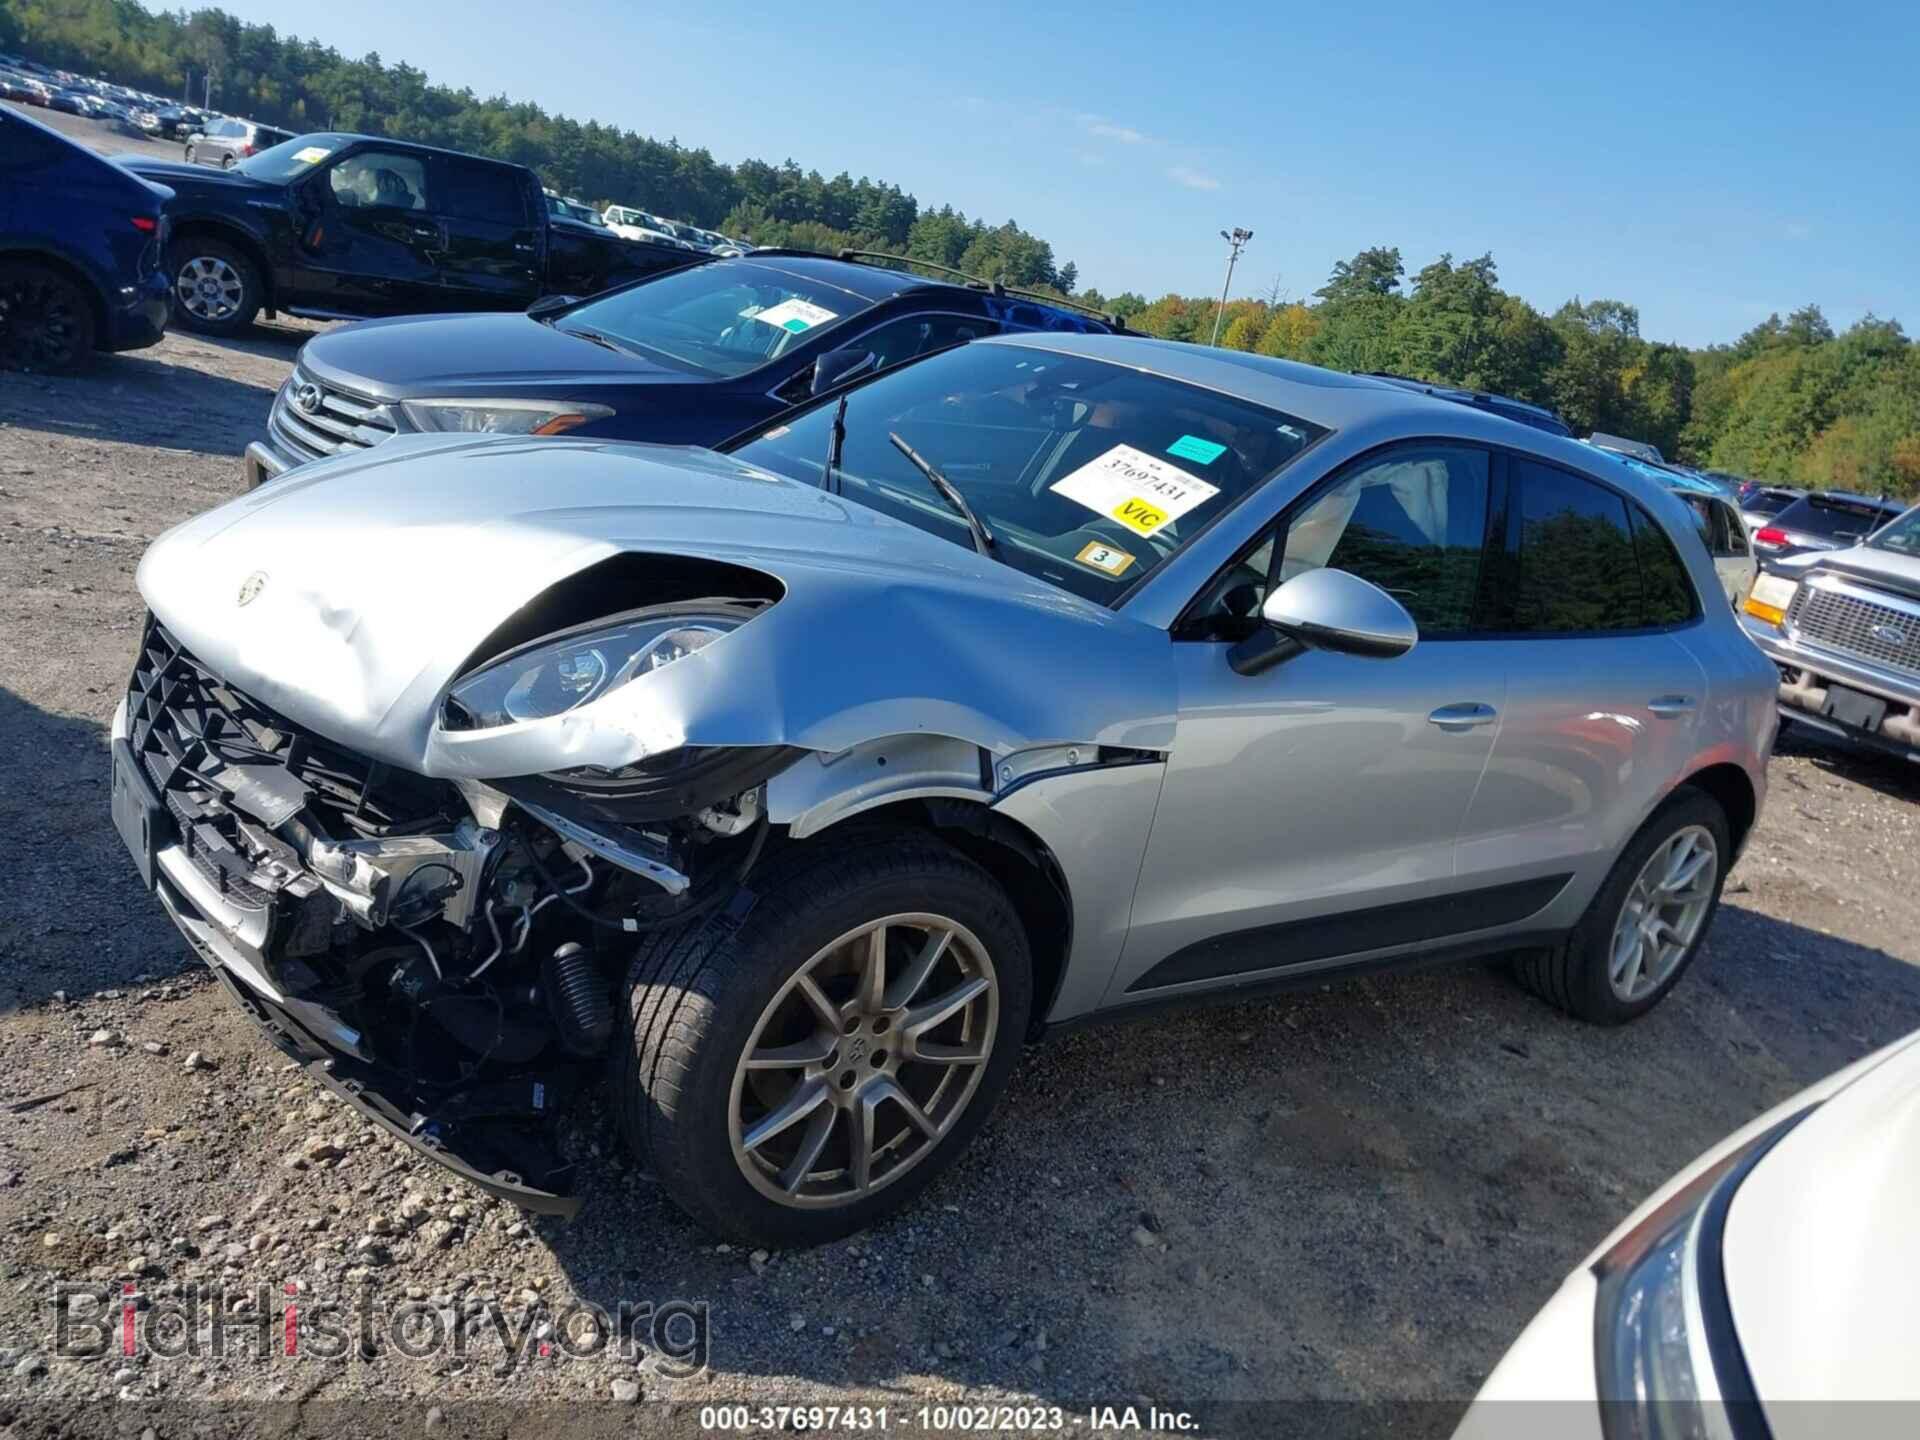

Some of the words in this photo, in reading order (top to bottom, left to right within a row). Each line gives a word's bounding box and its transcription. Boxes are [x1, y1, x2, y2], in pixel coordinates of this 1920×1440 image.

[1104, 458, 1187, 501] 37697431
[1122, 501, 1160, 527] VIC
[1093, 549, 1110, 562] 3
